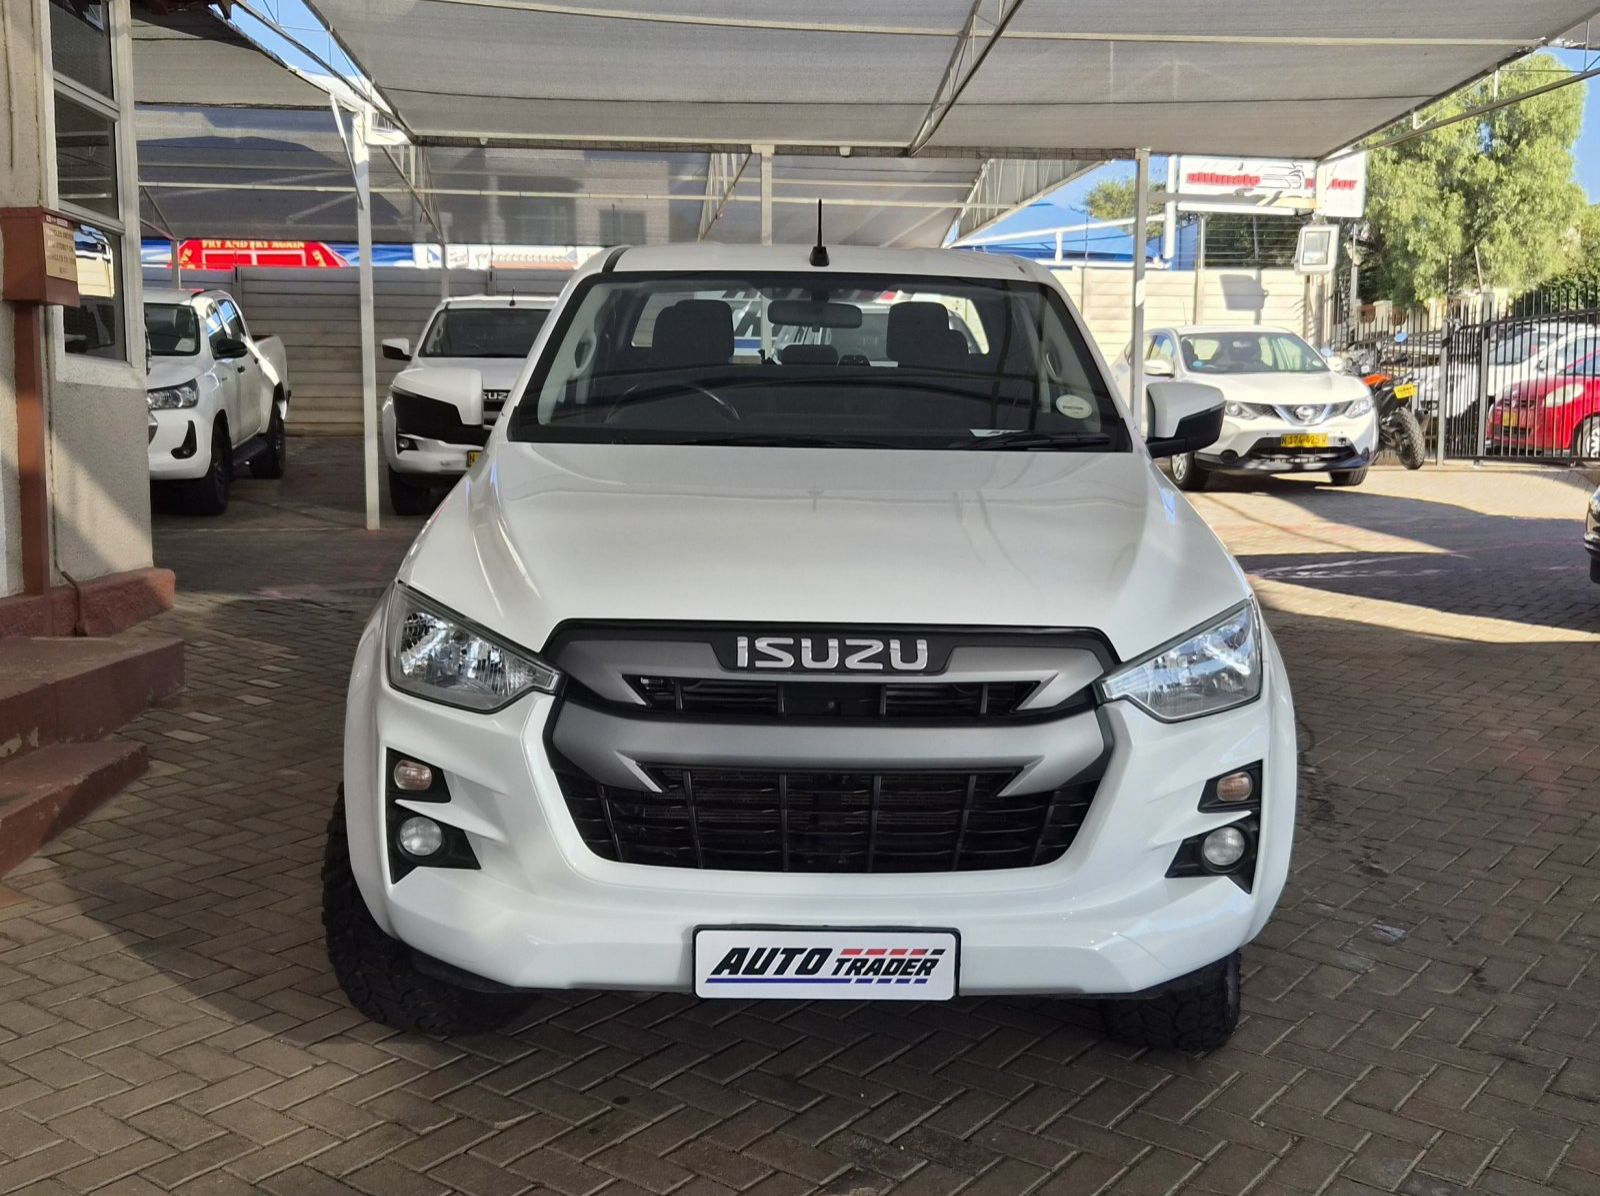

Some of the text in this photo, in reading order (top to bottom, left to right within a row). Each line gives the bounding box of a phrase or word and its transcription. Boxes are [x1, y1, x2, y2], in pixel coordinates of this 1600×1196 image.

[225, 239, 248, 249] AND
[271, 240, 305, 249] AGAIN
[737, 636, 928, 670] ISUZU
[710, 947, 940, 976] AUTO TRADER
